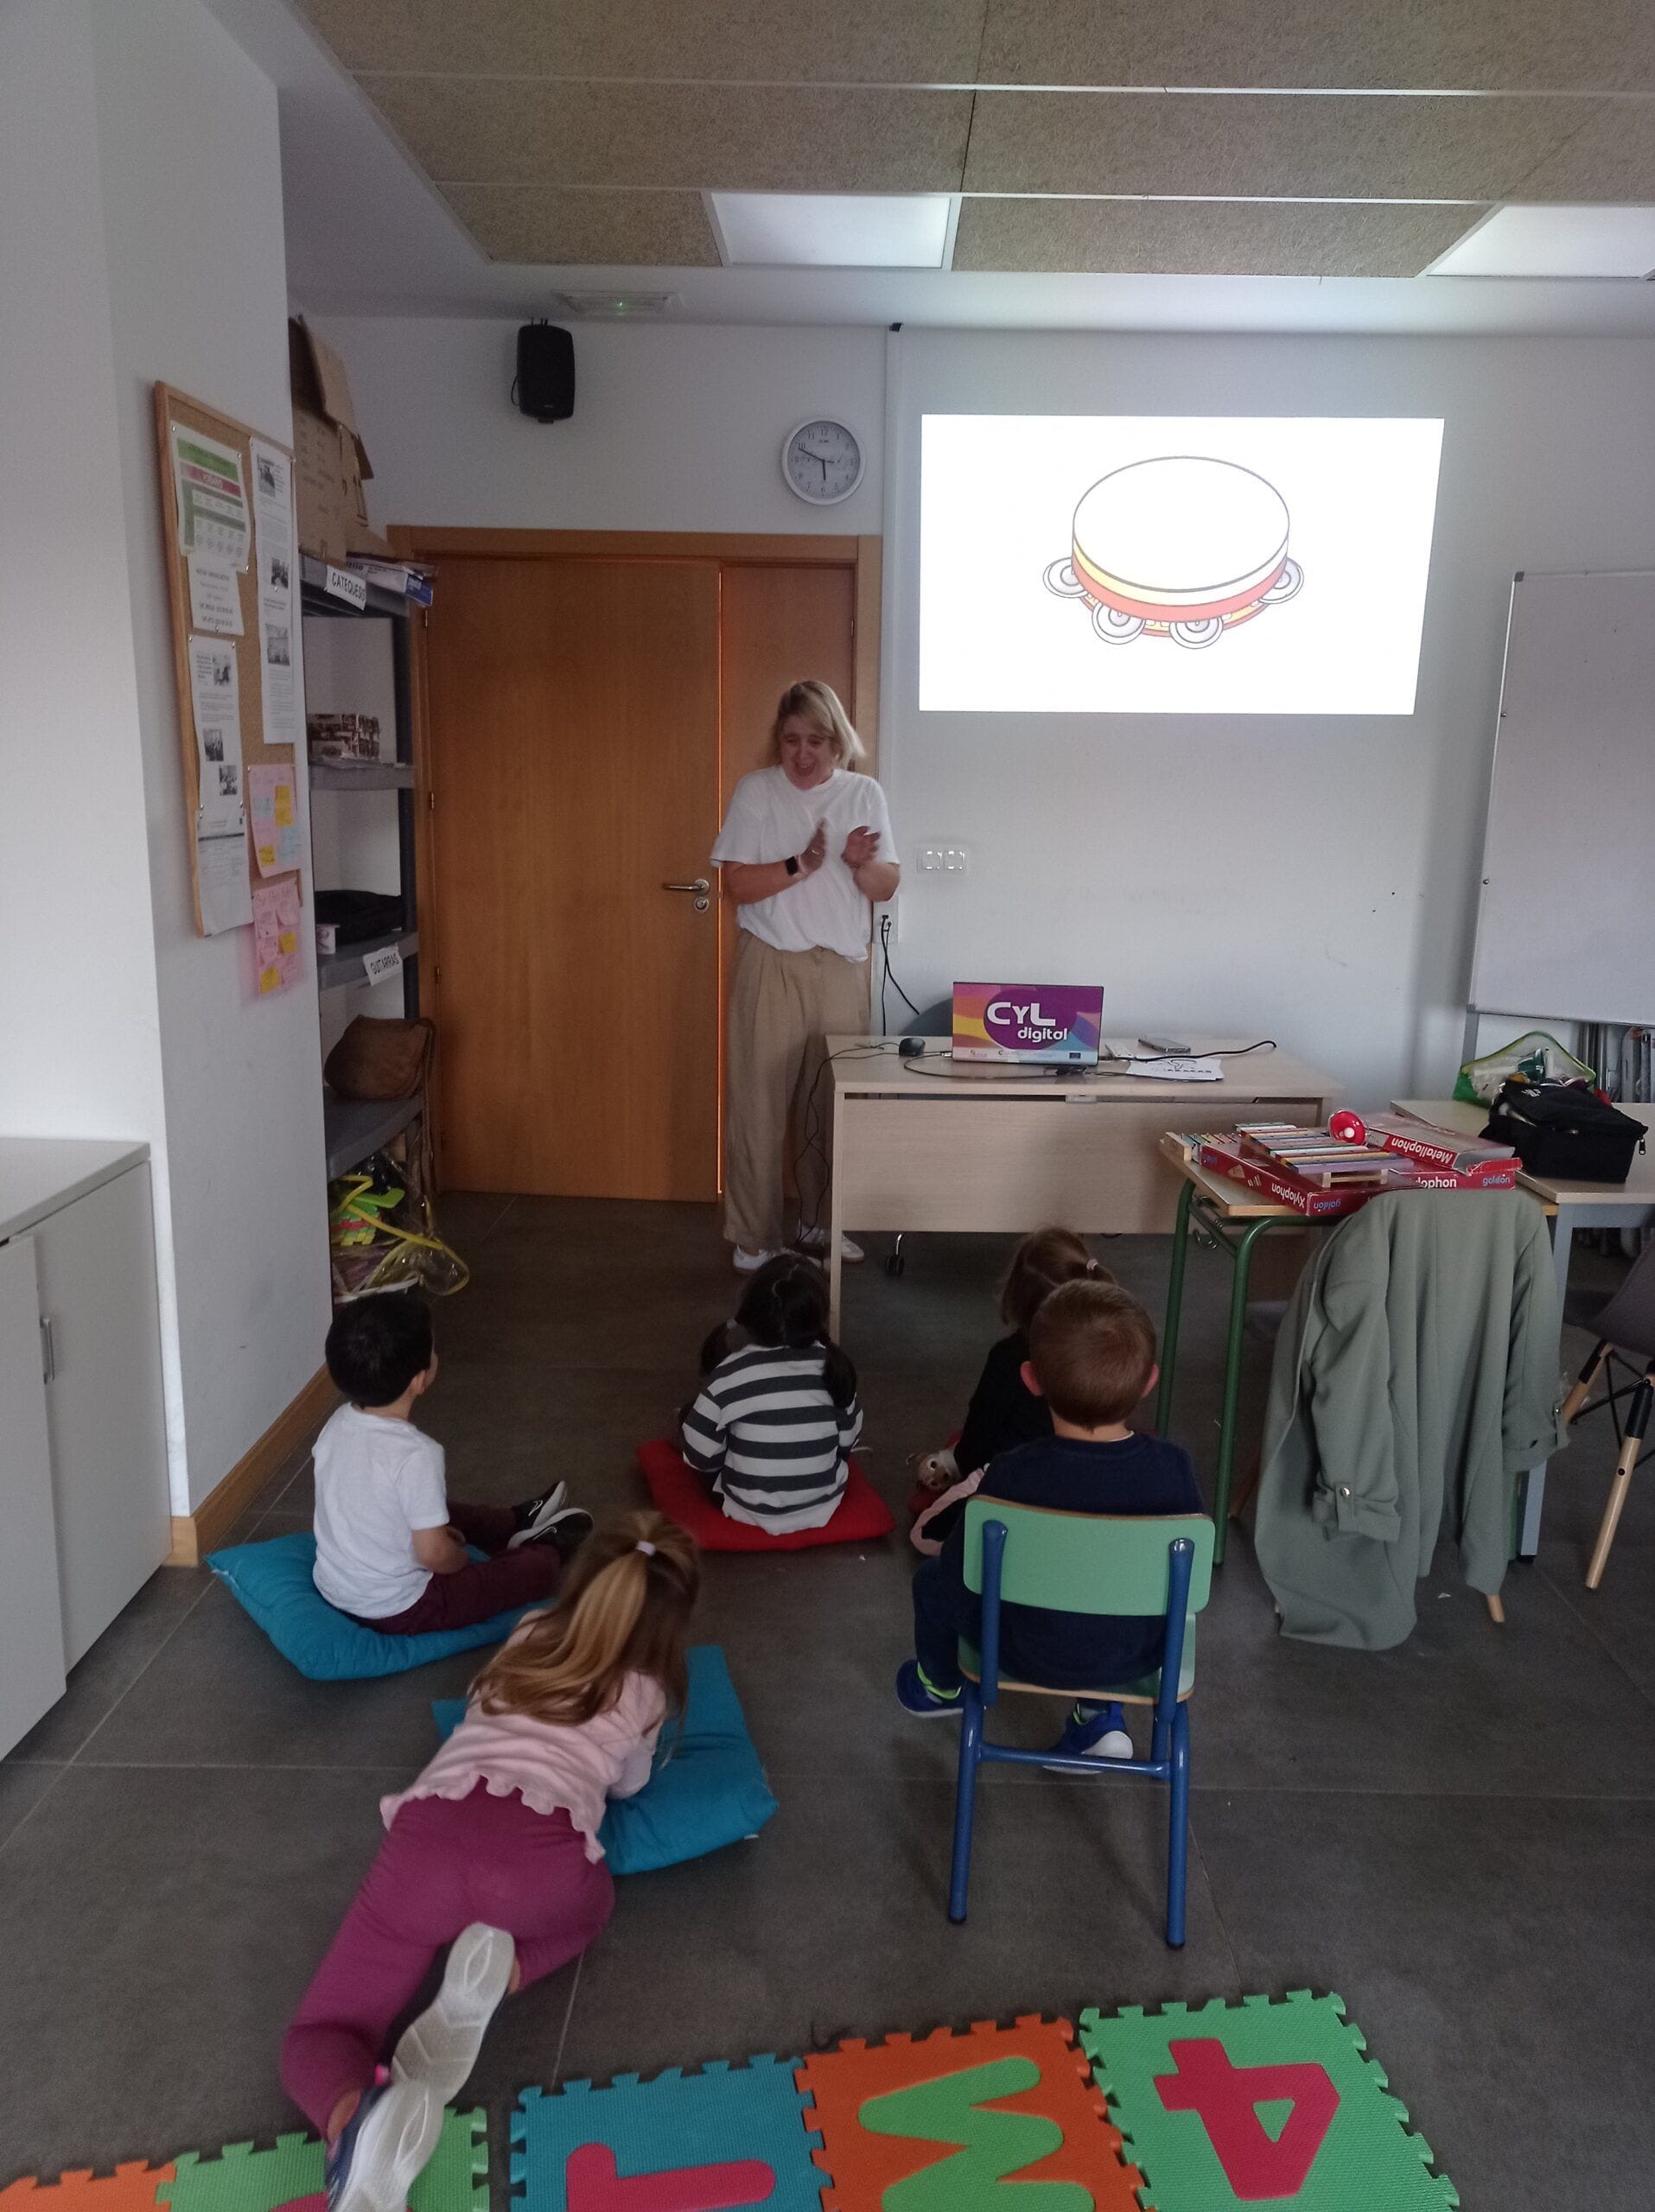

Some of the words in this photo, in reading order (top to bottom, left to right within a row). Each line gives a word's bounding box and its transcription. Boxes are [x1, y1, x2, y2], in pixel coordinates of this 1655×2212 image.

[332, 573, 366, 601] CATEQUESIS
[370, 953, 399, 974] GUITARRAS
[1017, 1027, 1068, 1043] digital
[1391, 1137, 1454, 1164] Metallophon
[1482, 1174, 1511, 1187] goldon
[1271, 1182, 1306, 1209] Xylophon
[1153, 2037, 1340, 2202] 4
